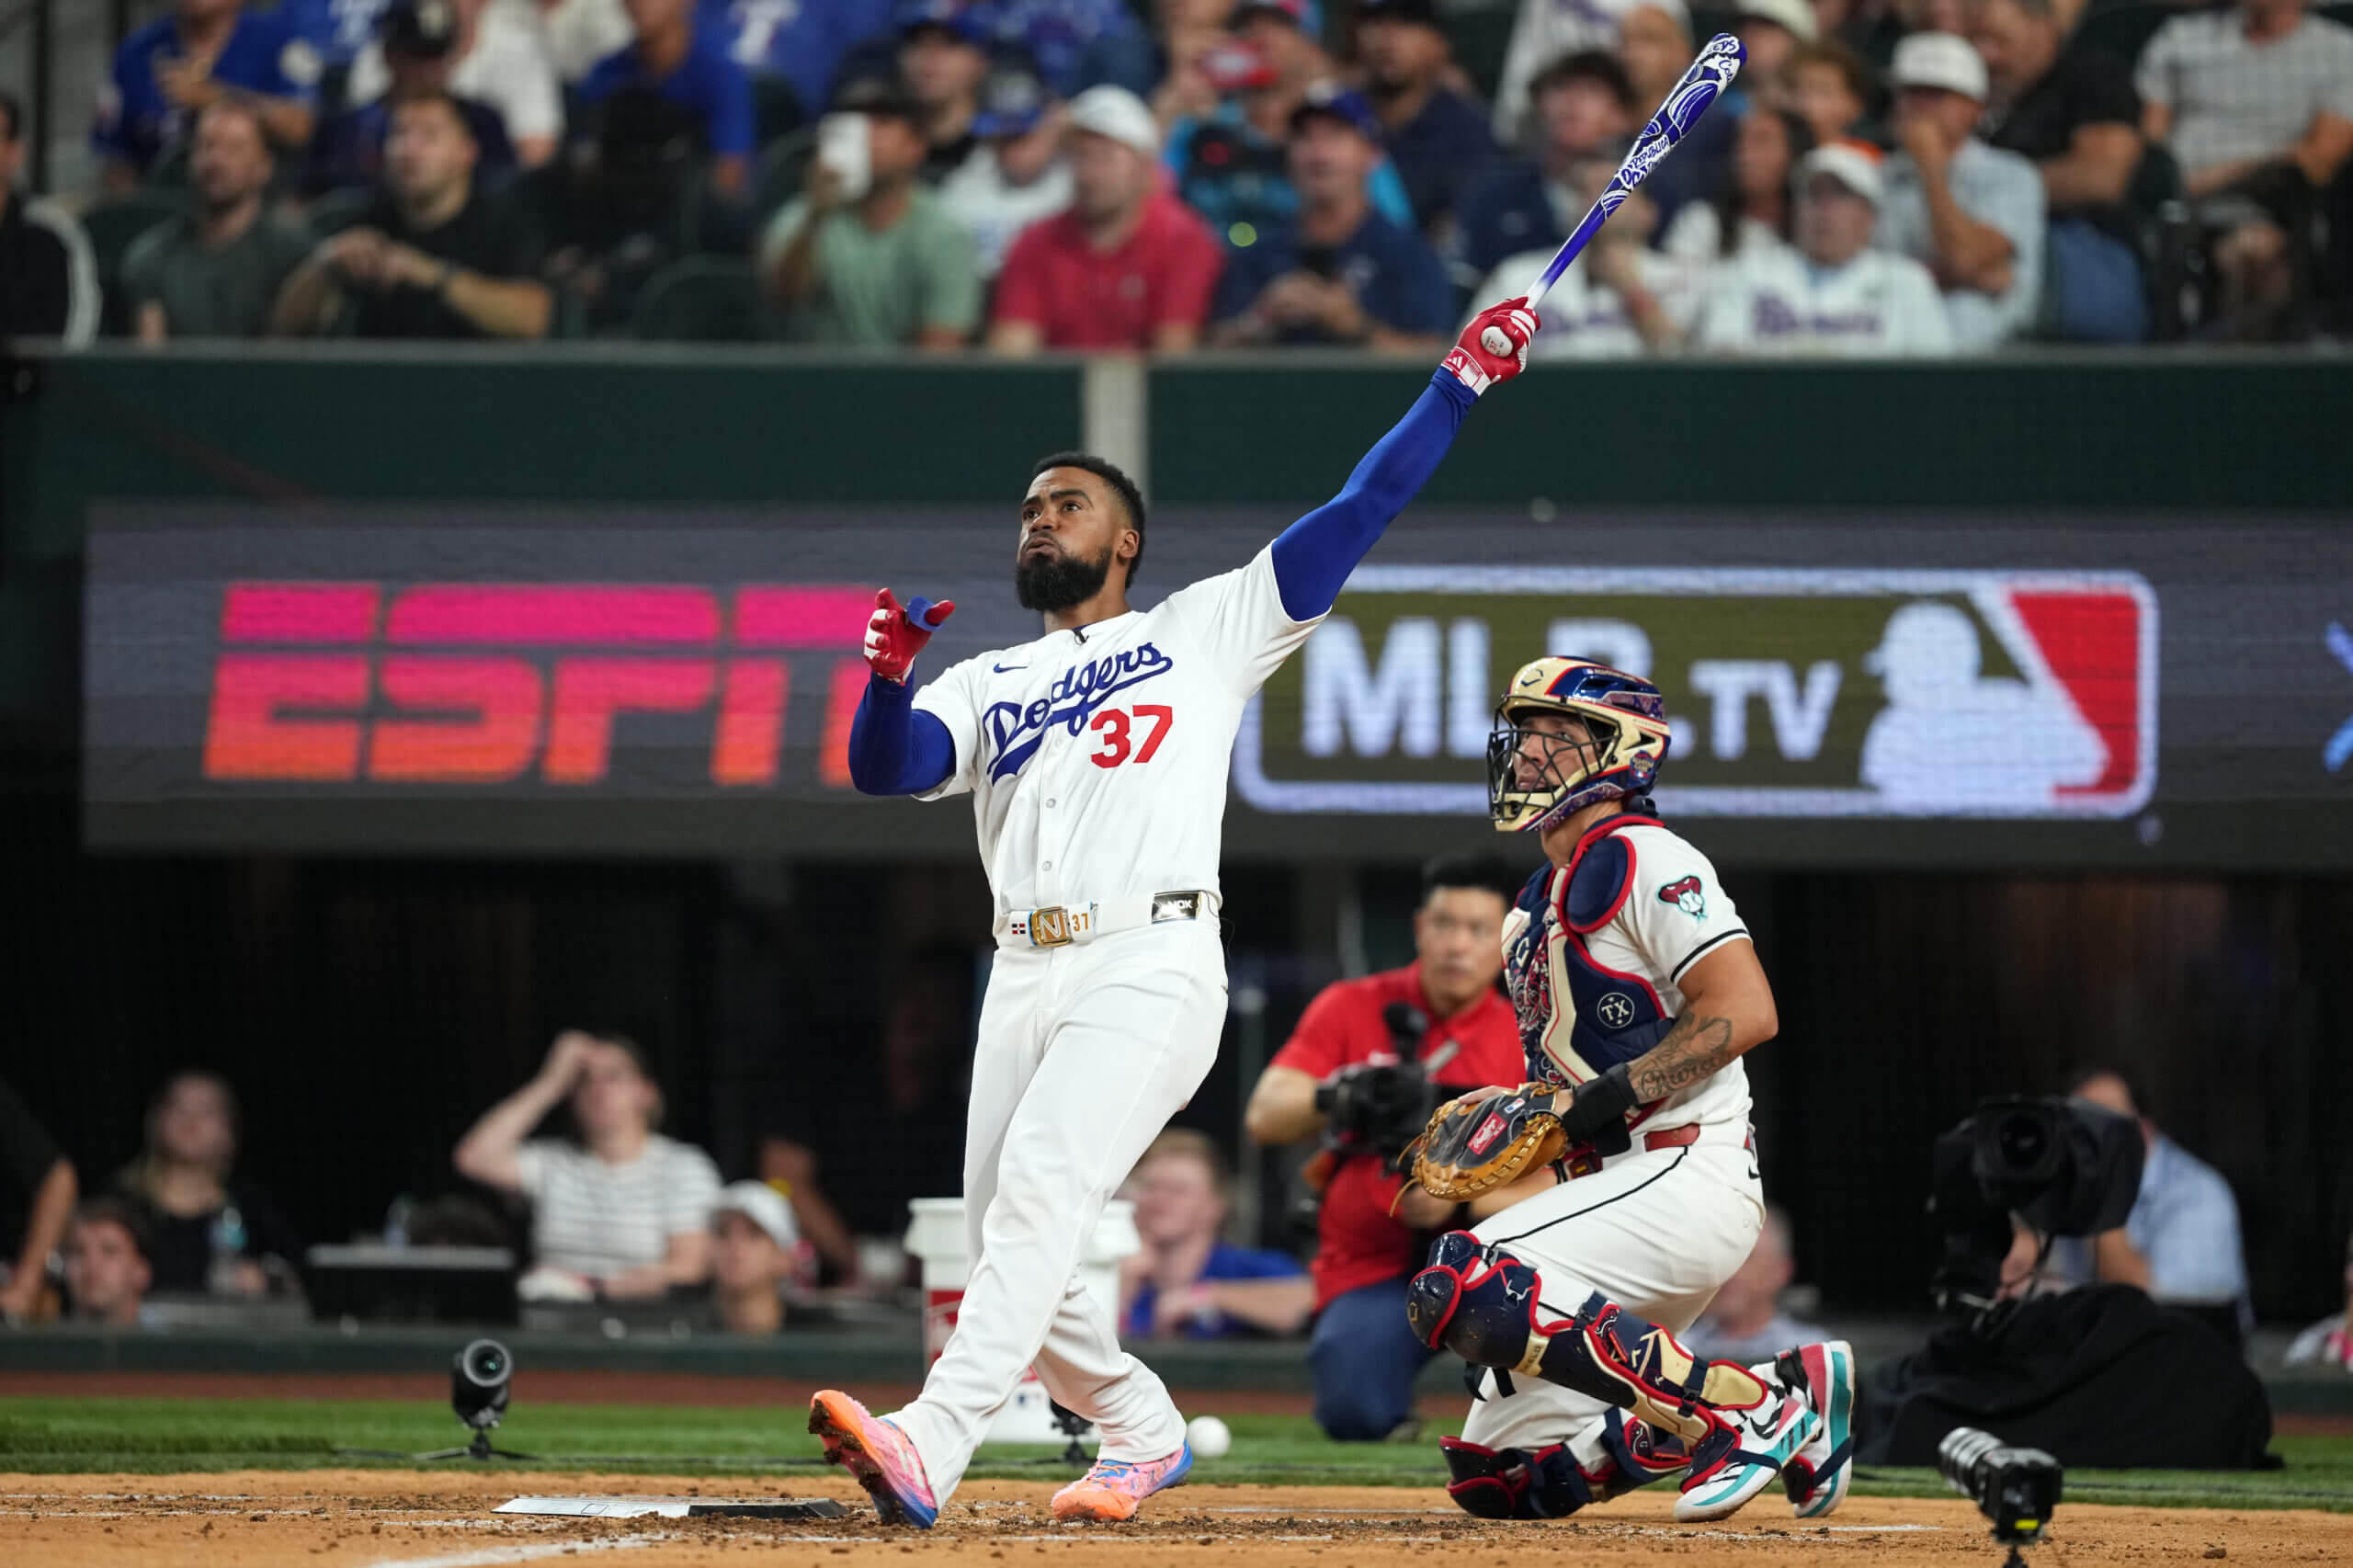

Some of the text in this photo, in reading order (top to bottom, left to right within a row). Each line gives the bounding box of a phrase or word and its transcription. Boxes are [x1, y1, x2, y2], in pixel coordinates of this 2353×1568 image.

[202, 582, 874, 784] ESPN
[983, 642, 1173, 788] Dodgers
[1090, 705, 1173, 768] 37
[1072, 913, 1089, 932] 37
[1601, 999, 1630, 1020] TX
